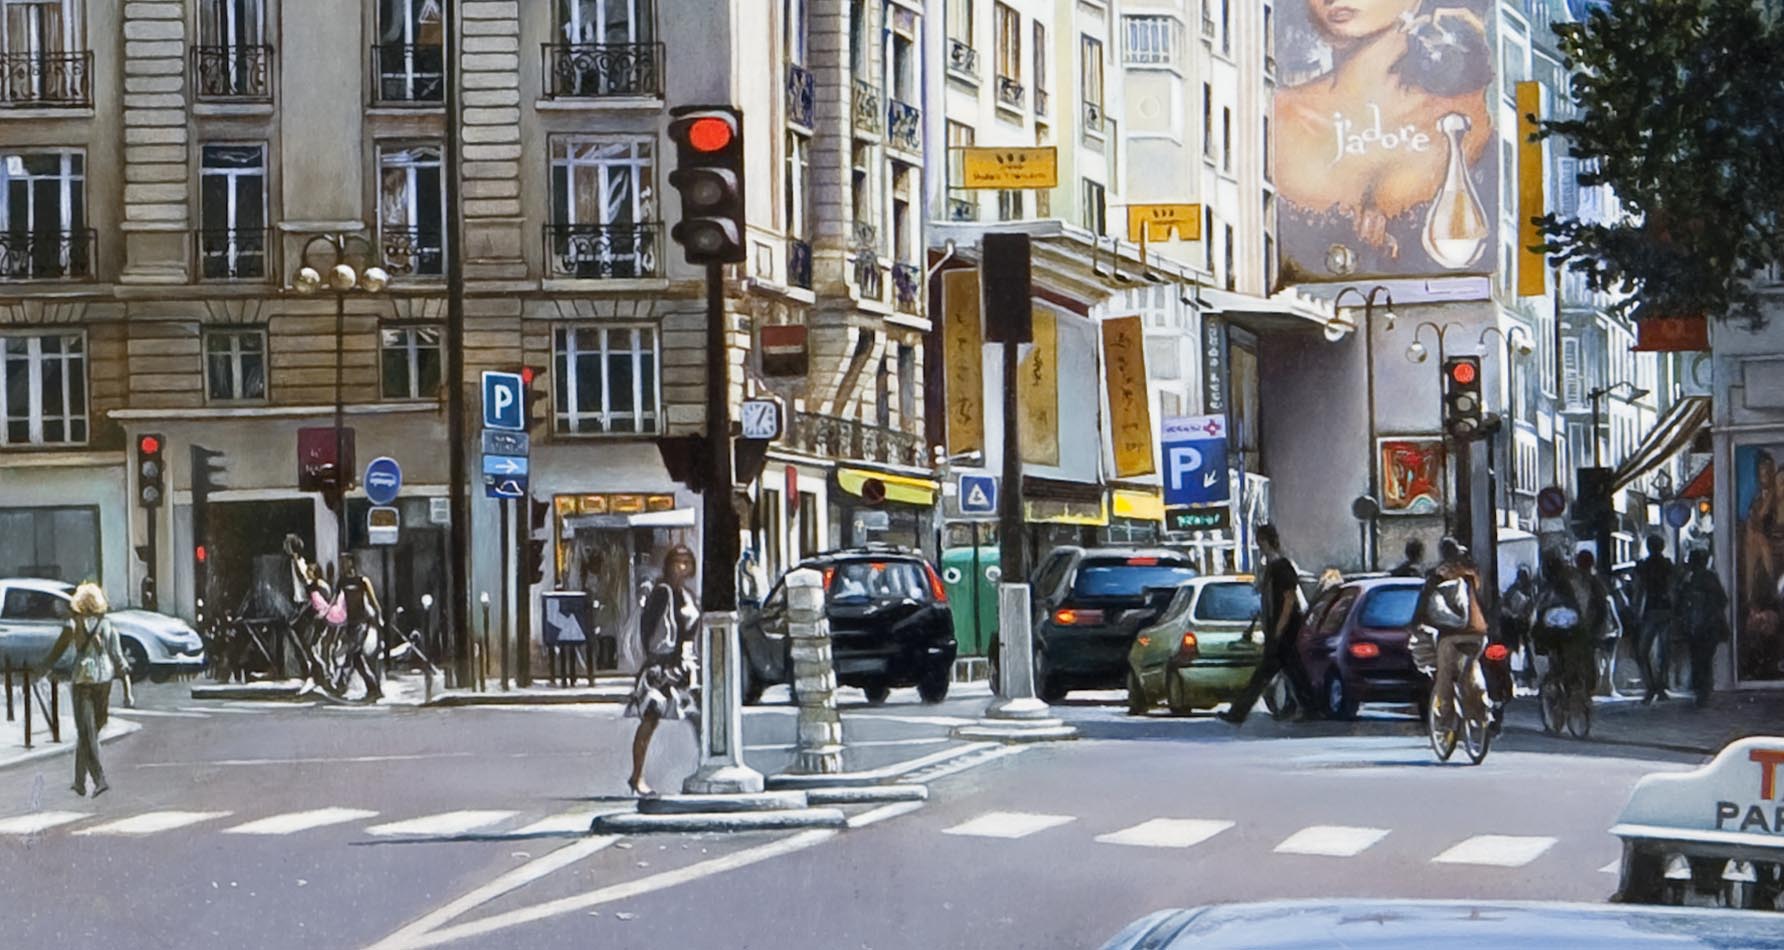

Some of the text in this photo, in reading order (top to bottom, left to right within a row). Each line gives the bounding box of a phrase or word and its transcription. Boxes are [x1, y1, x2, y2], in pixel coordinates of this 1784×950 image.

[1329, 102, 1430, 166] j'adore
[494, 384, 513, 419] P
[1170, 447, 1202, 490] P
